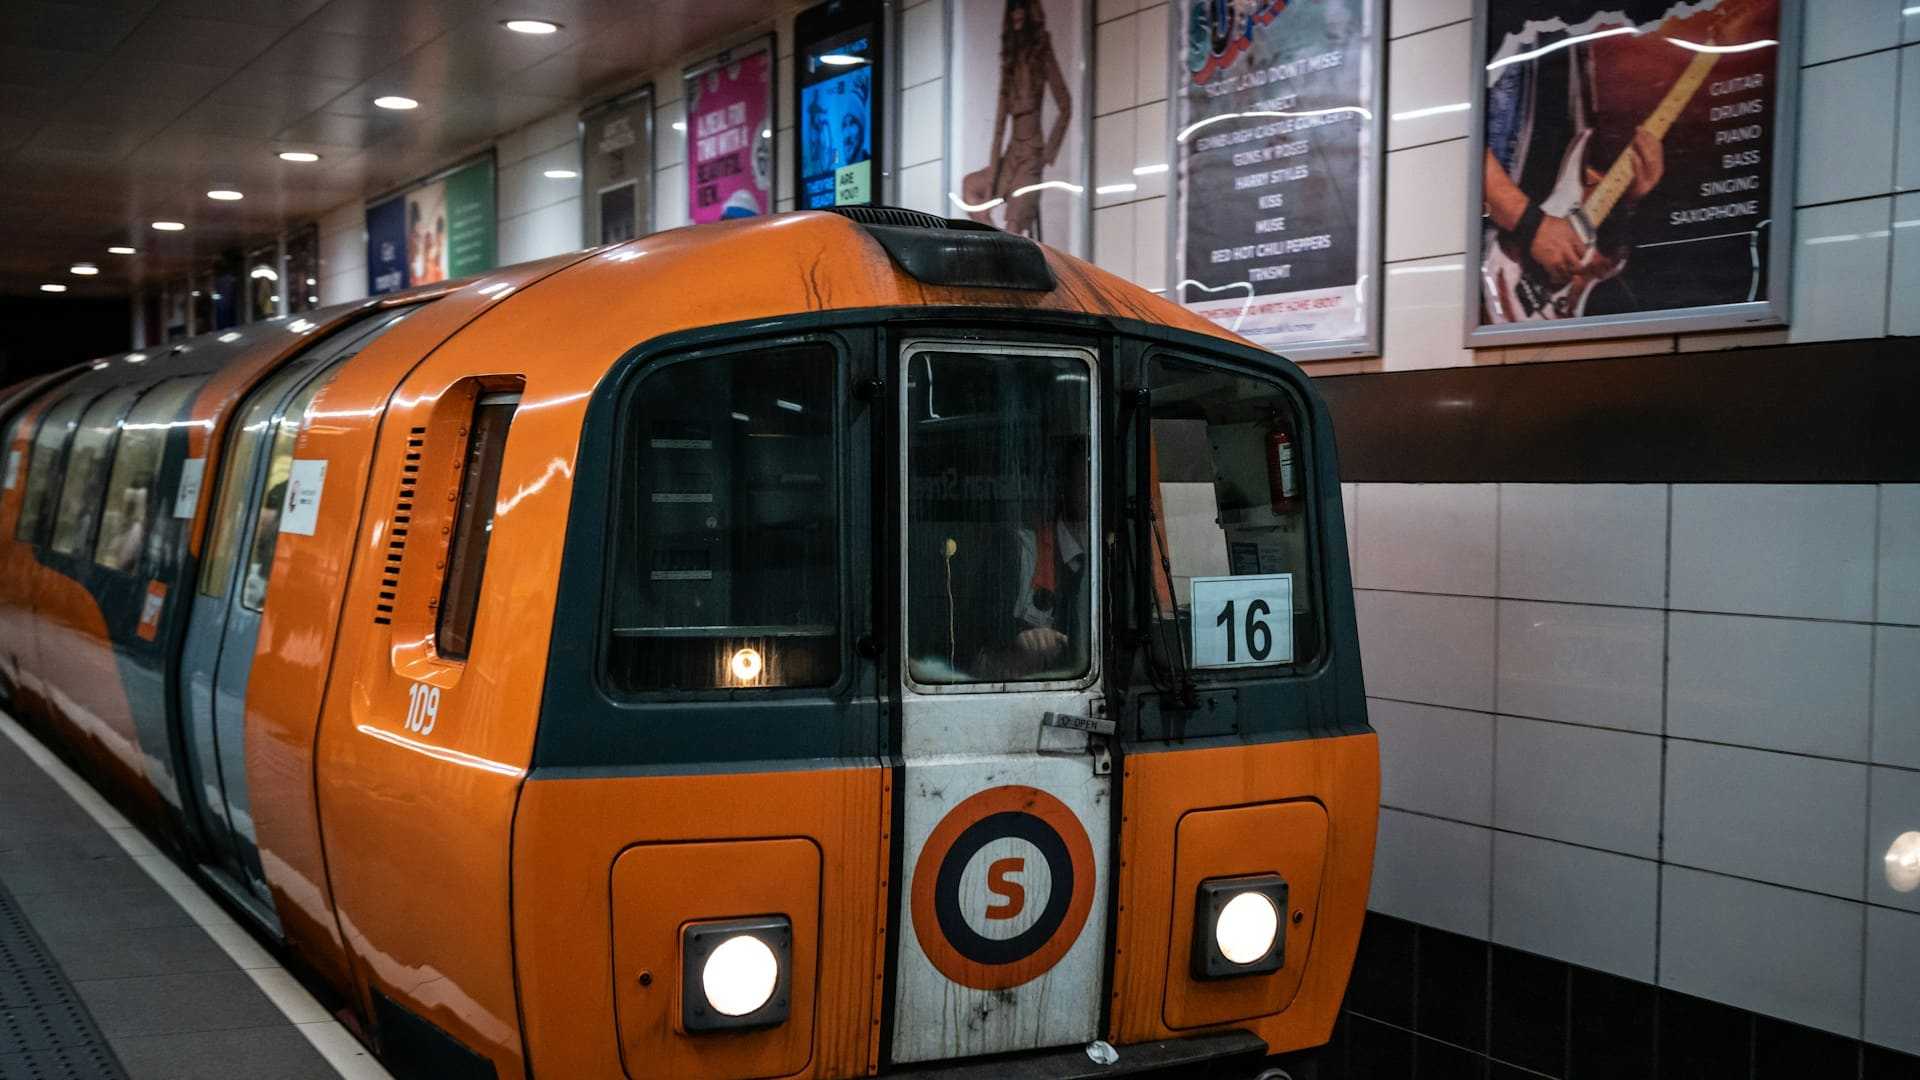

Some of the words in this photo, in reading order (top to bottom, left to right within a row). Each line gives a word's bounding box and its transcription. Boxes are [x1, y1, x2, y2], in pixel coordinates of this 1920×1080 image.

[1709, 73, 1763, 96] GUITAR
[1710, 99, 1763, 121] DRUMS
[1715, 125, 1762, 145] PIANO
[1233, 150, 1262, 167] GUNS
[1276, 140, 1309, 159] ROSES
[1722, 150, 1761, 169] BASS
[840, 172, 854, 187] ARE
[1234, 172, 1268, 190] HARRY
[1270, 165, 1309, 185] STYLES
[1701, 175, 1759, 197] SINGING
[840, 187, 859, 202] YOU?
[1257, 194, 1283, 210] KISS
[1670, 200, 1759, 226] SAXOPHONE
[1255, 217, 1286, 234] MUSE
[1210, 249, 1231, 264] RED
[1232, 246, 1254, 262] HOT
[1256, 241, 1284, 259] CHILI
[1286, 234, 1331, 254] PEPPERS
[1216, 599, 1273, 663] 16
[404, 683, 440, 736] 109
[1074, 718, 1098, 730] OPEN
[985, 857, 1025, 920] S
